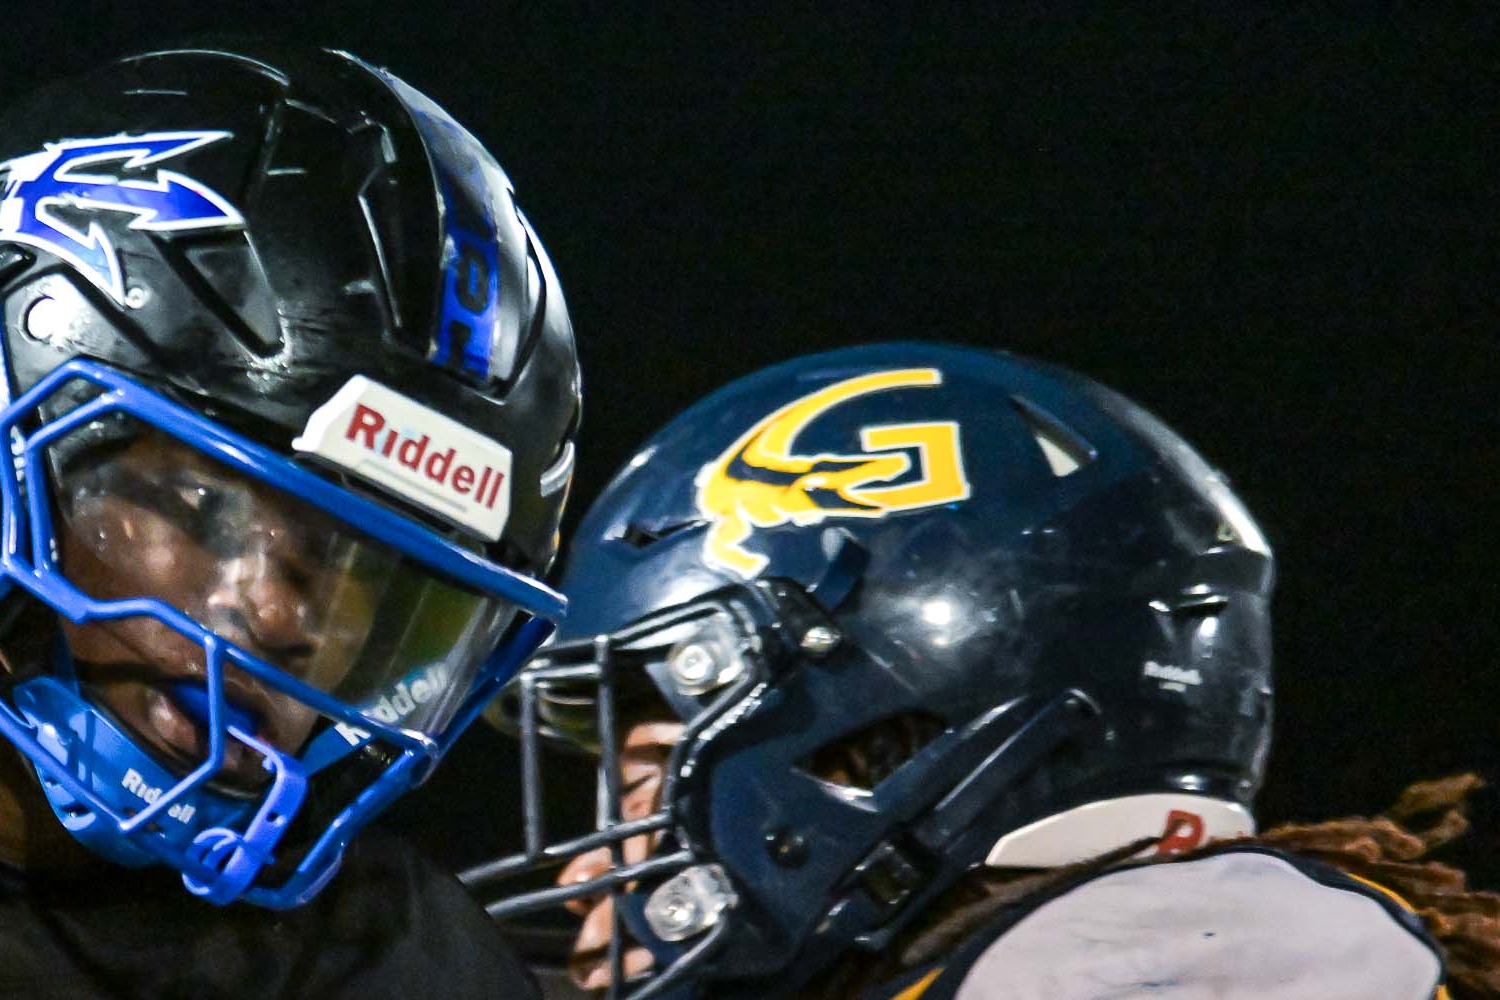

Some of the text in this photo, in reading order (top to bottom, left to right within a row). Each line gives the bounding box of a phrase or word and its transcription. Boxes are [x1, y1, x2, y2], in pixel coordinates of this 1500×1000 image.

[345, 402, 505, 510] Riddell
[334, 661, 449, 747] Rddell
[121, 767, 197, 824] Ridell
